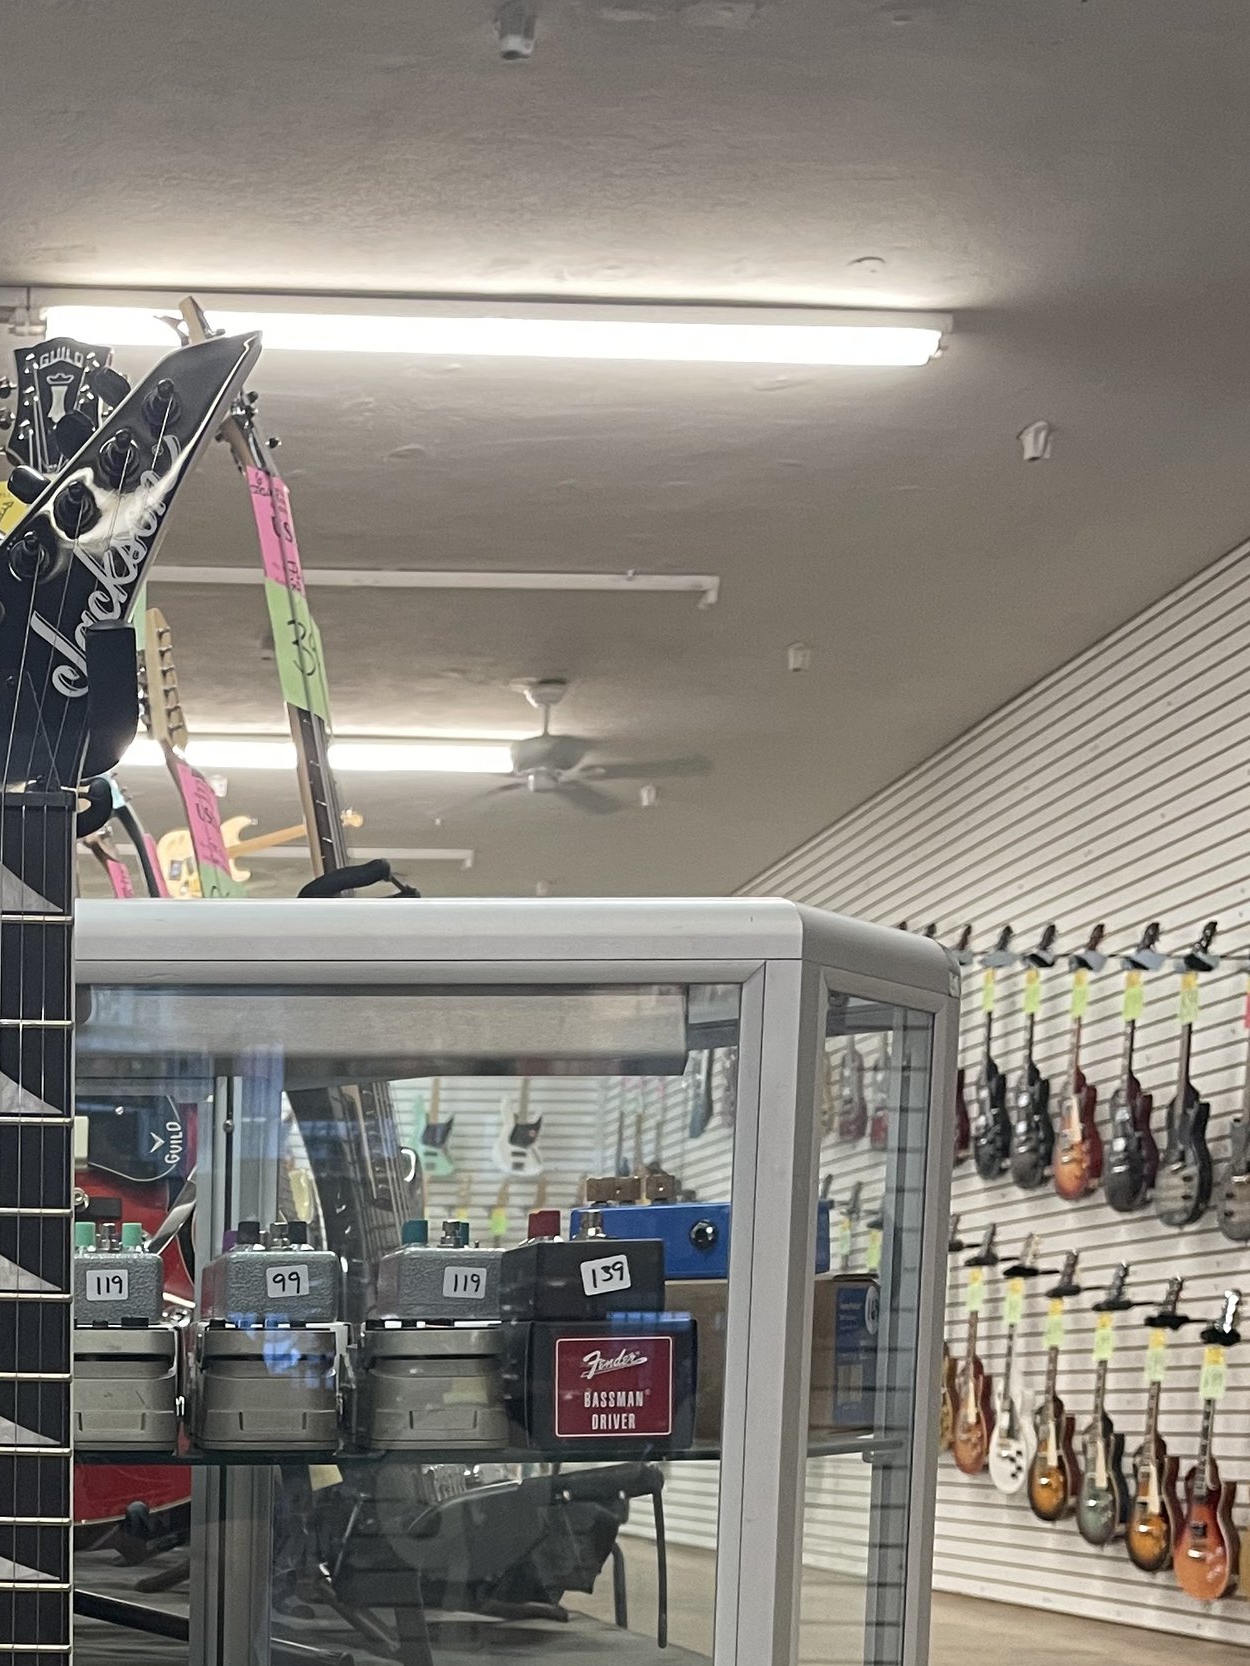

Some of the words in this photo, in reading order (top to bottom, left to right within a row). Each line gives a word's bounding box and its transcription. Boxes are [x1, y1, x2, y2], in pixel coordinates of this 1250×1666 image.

[38, 346, 85, 370] GUILD
[164, 1121, 184, 1164] GUILD
[96, 1275, 124, 1296] 119
[272, 1271, 301, 1294] 99
[453, 1273, 481, 1293] 119
[591, 1261, 625, 1289] 139
[580, 1348, 648, 1380] Fender
[583, 1391, 645, 1408] BASSMAN
[591, 1414, 636, 1430] DRIVER
